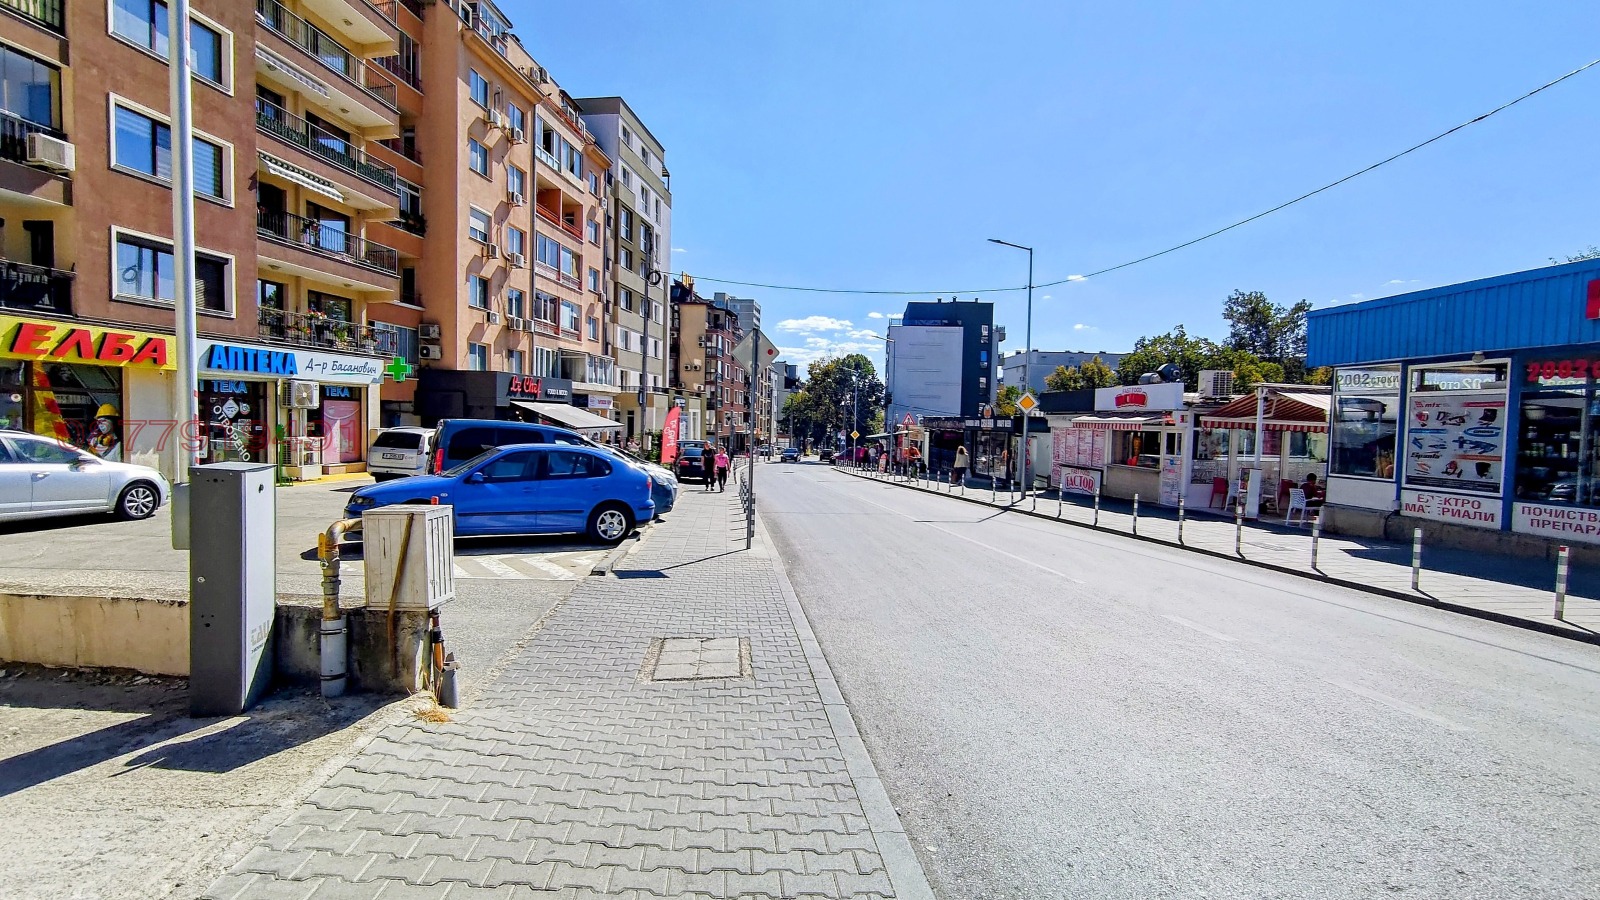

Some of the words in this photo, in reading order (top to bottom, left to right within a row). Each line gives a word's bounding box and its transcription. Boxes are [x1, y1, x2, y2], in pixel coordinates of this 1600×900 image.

[11, 323, 168, 365] ЕЛБА
[208, 345, 298, 375] АПТЕКА
[305, 358, 328, 374] Д-р
[332, 360, 377, 374] Басанович
[1337, 374, 1370, 385] 2002
[1527, 360, 1588, 381] 2002
[510, 375, 522, 391] Le
[523, 376, 543, 399] Chef
[213, 405, 251, 461] ОТВОРЕНО
[1065, 475, 1094, 492] FACTOR
[1405, 503, 1495, 522] МАРИАЛИ
[1521, 506, 1600, 523] ПОЧИСТВ
